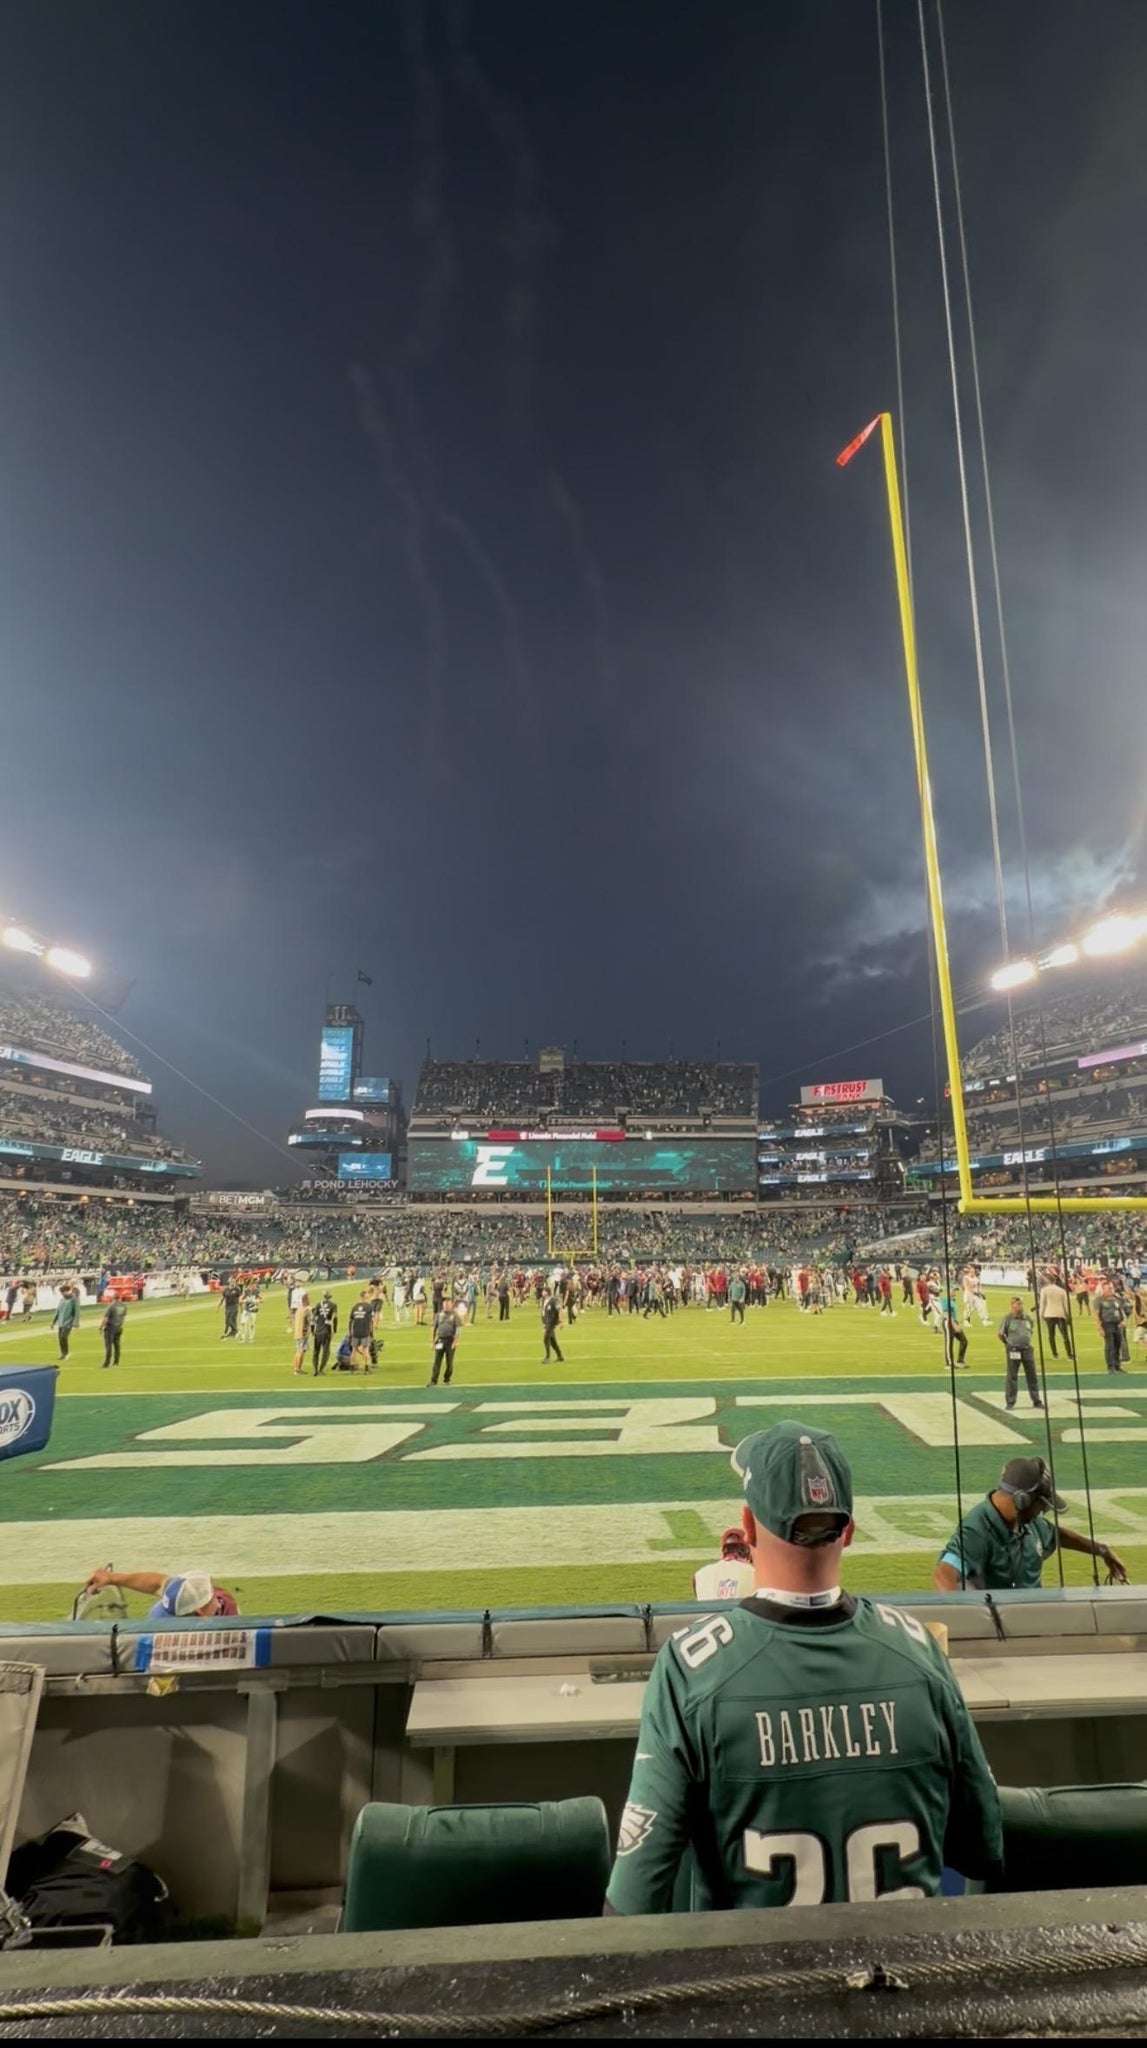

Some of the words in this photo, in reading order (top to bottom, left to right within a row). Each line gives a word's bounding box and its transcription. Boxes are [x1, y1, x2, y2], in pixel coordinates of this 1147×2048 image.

[61, 1148, 104, 1165] EAGLE
[1003, 1148, 1046, 1165] EAGLE
[314, 1180, 345, 1189] POND
[348, 1180, 399, 1189] LEHOCKY
[219, 1195, 265, 1204] BETMGM
[755, 1701, 898, 1766] BARKLEY
